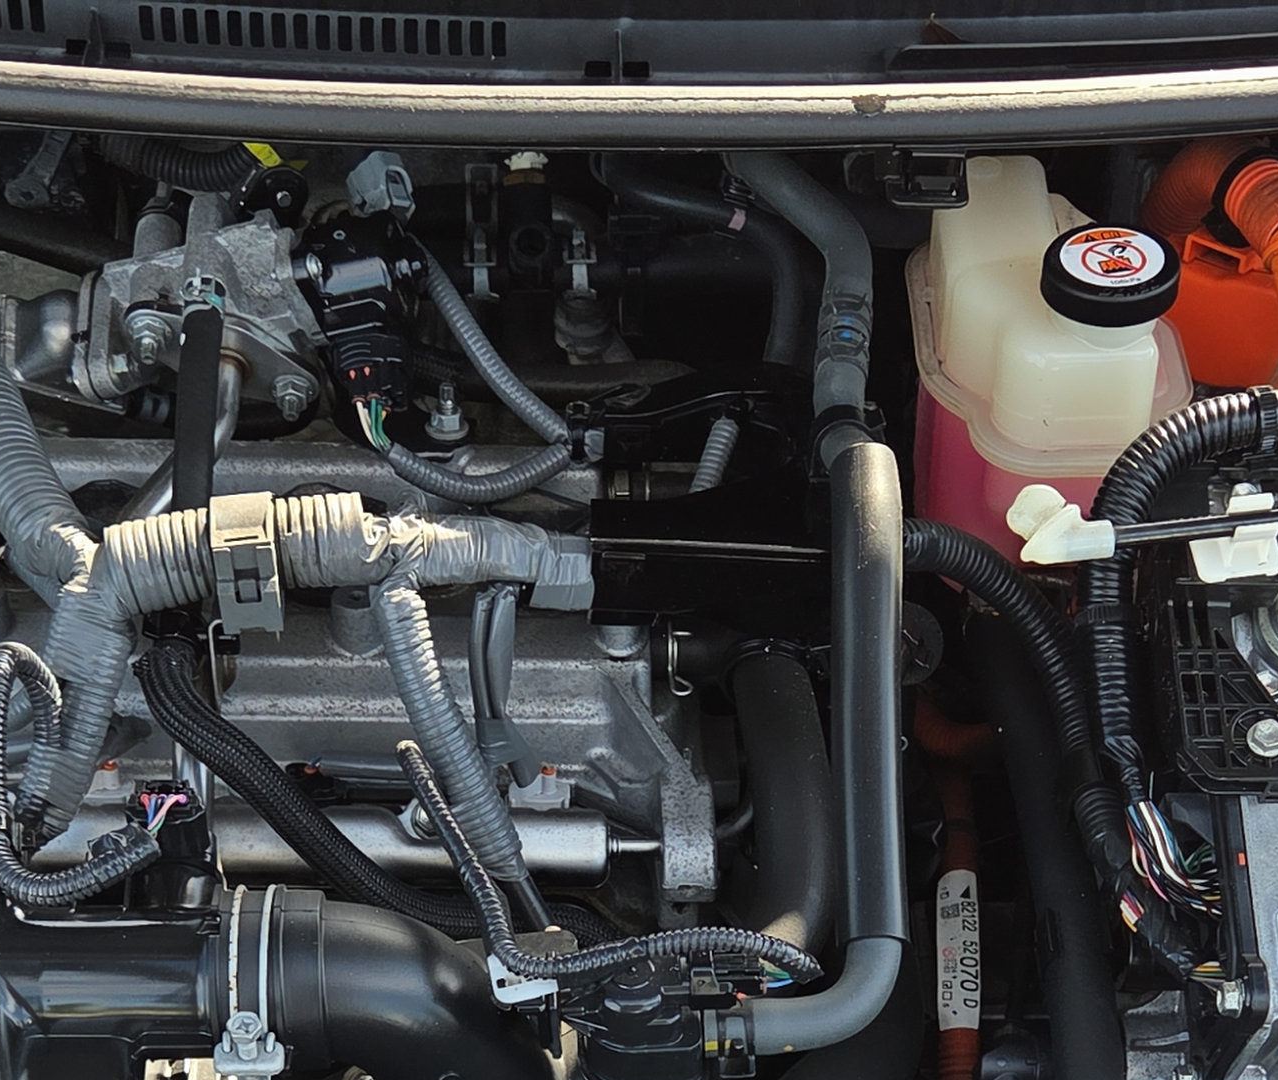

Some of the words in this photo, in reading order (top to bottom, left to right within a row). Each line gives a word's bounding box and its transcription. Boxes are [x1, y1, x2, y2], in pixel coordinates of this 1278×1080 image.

[961, 901, 977, 932] 82122
[960, 939, 979, 993] 52070
[963, 998, 979, 1009] D
